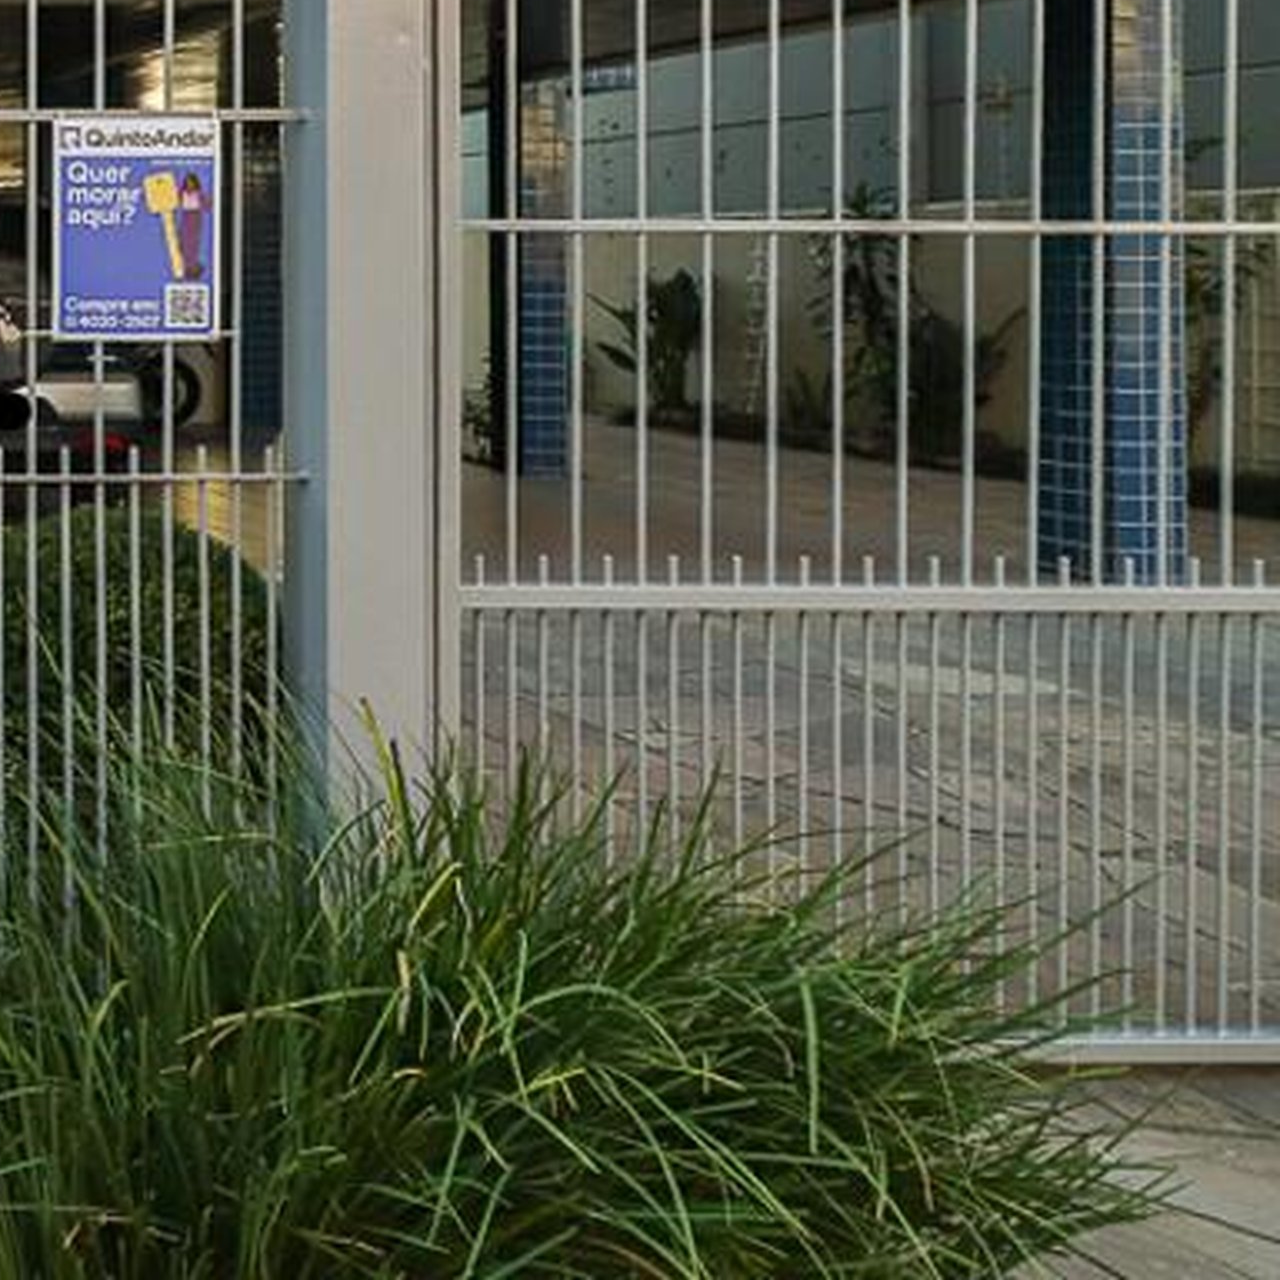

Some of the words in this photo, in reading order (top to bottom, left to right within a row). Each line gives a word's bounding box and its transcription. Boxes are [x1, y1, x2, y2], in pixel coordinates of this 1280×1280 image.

[85, 128, 214, 148] QuintoAndar
[67, 160, 132, 183] Quer
[67, 187, 141, 204] morar
[67, 204, 137, 230] aqui?
